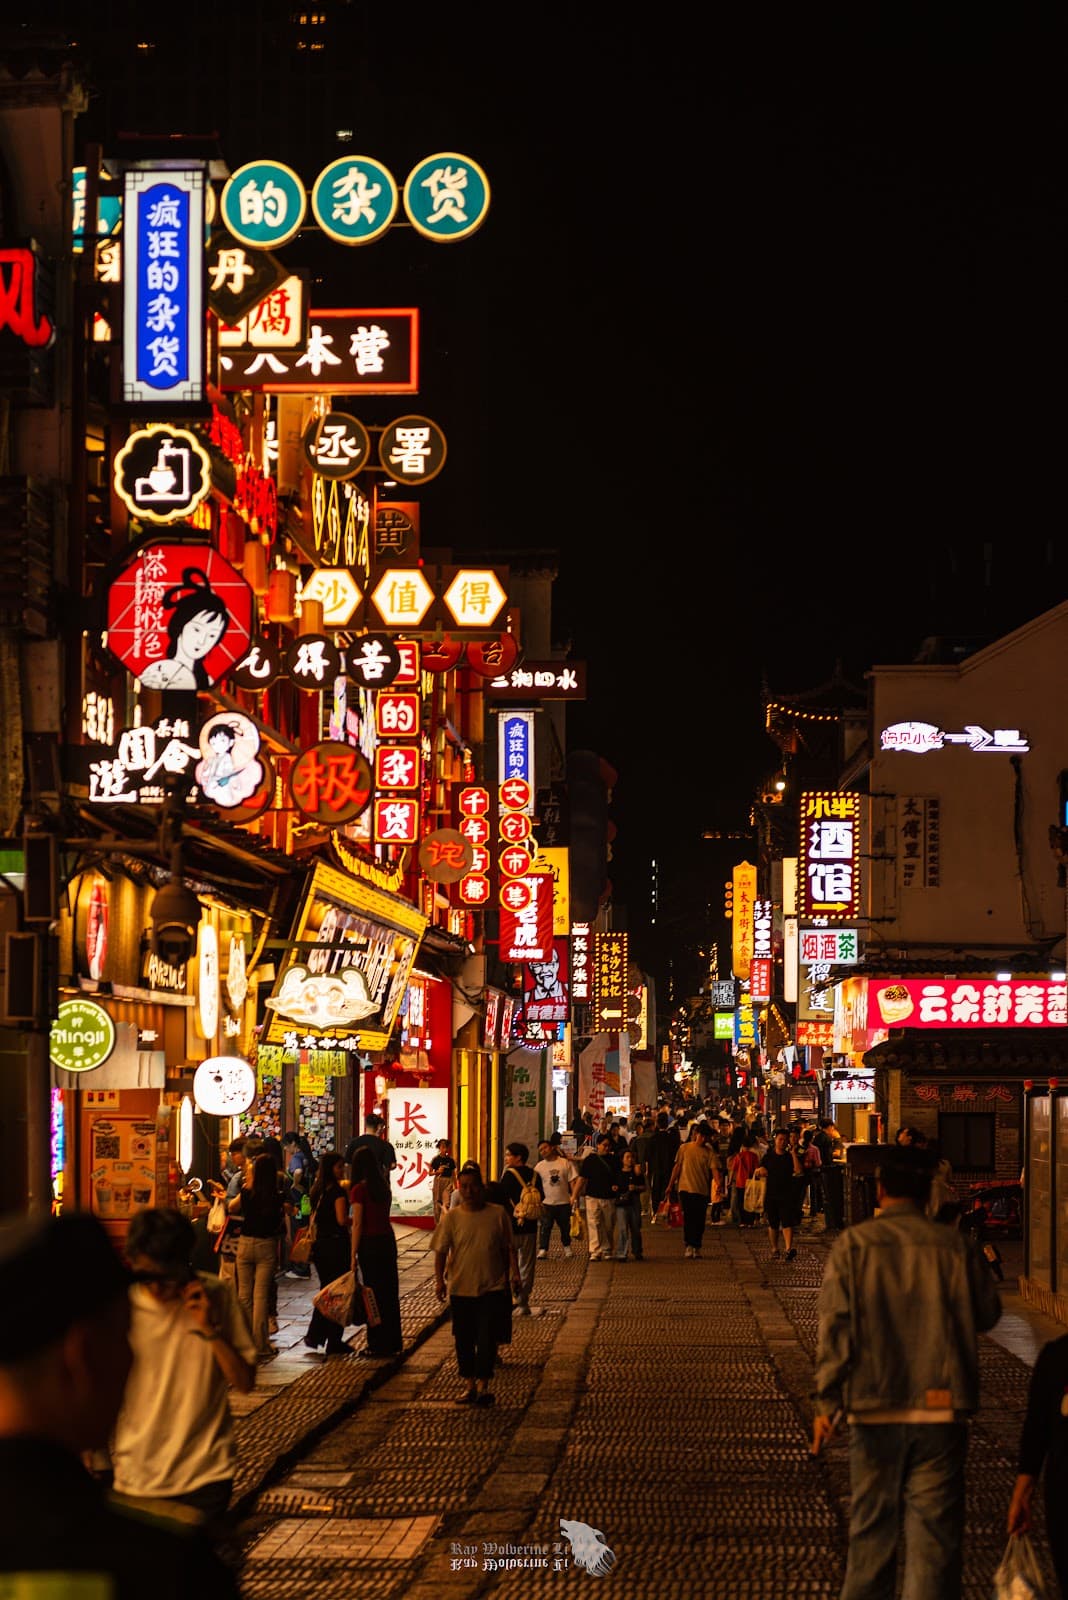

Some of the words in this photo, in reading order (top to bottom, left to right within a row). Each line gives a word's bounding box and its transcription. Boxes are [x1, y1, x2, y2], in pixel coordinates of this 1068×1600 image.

[146, 195, 182, 377] 疯狂的杂货
[208, 248, 255, 294] 丹
[141, 549, 168, 658] 茶颜悦色
[293, 749, 370, 812] 极
[808, 821, 853, 902] 酒馆
[573, 937, 588, 997] 长沙米酒
[609, 942, 622, 997] 长沙记忆
[802, 933, 855, 960] 烟酒茶
[527, 1005, 568, 1020] 肯德基
